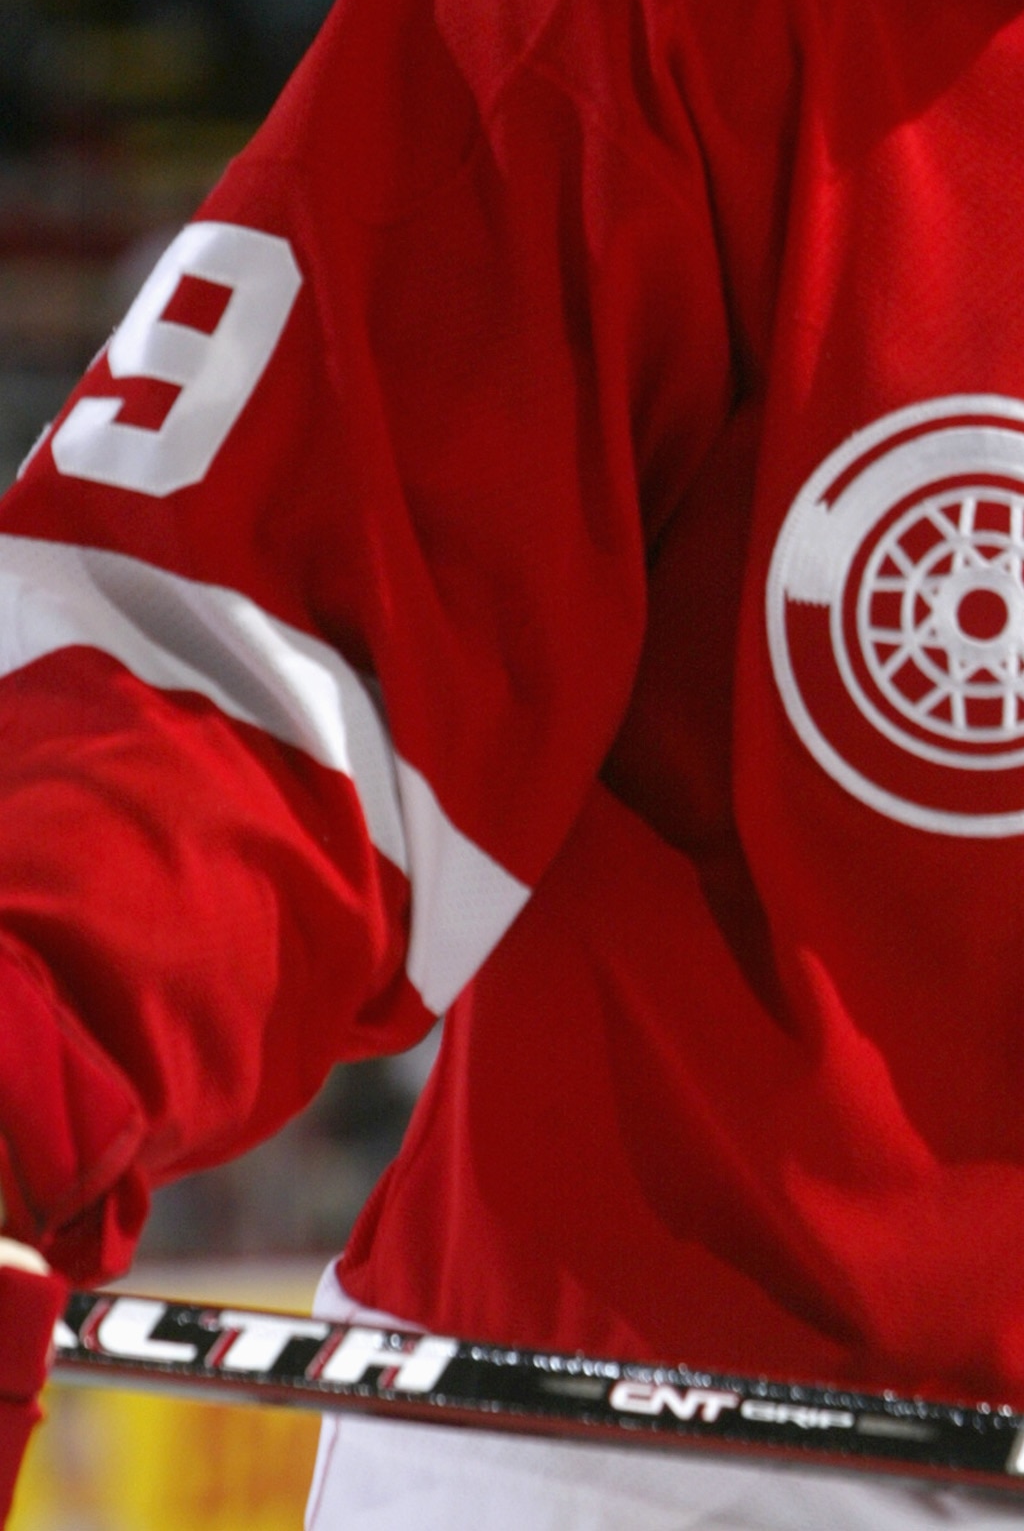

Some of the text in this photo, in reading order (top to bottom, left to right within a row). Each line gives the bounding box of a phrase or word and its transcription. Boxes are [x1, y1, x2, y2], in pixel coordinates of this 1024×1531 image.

[17, 220, 304, 498] 9
[54, 1296, 458, 1393] LTH
[609, 1379, 740, 1423] CNT
